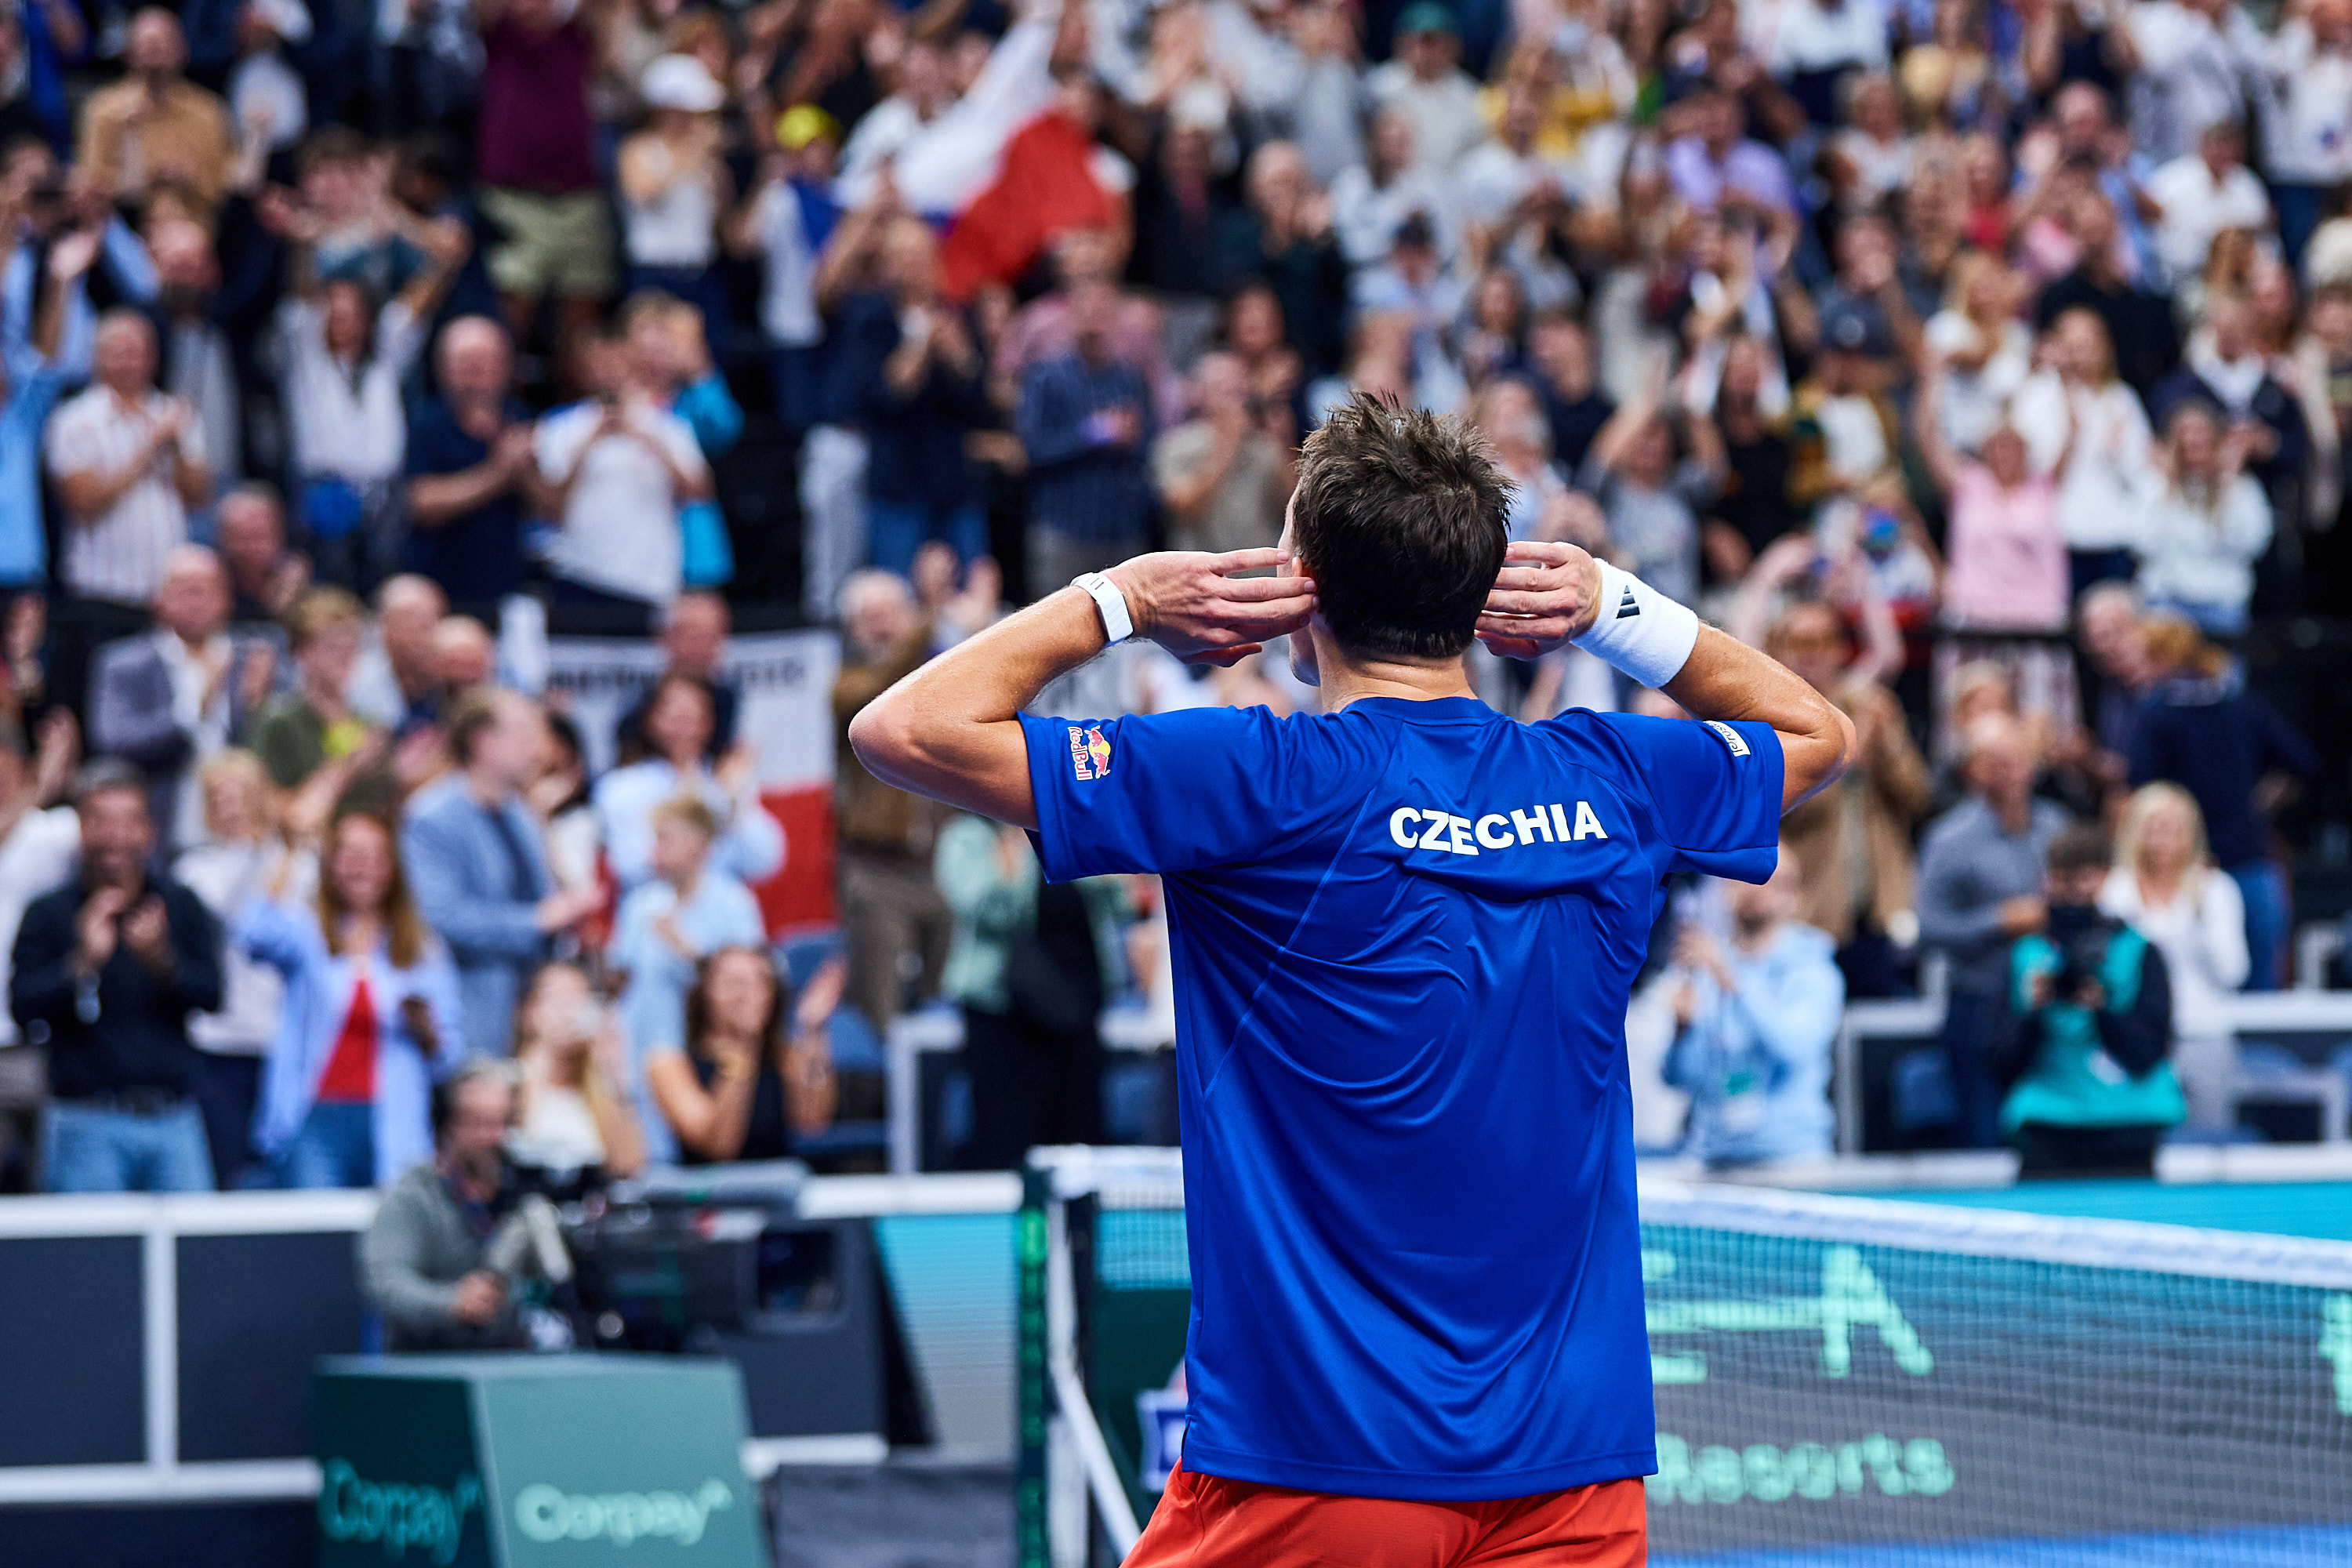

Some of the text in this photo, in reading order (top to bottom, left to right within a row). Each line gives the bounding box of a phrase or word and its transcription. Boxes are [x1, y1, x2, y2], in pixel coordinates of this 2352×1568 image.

[1068, 727, 1093, 780] Red Bull
[1389, 800, 1608, 856] CZECHIA
[514, 1483, 710, 1548] Corpay
